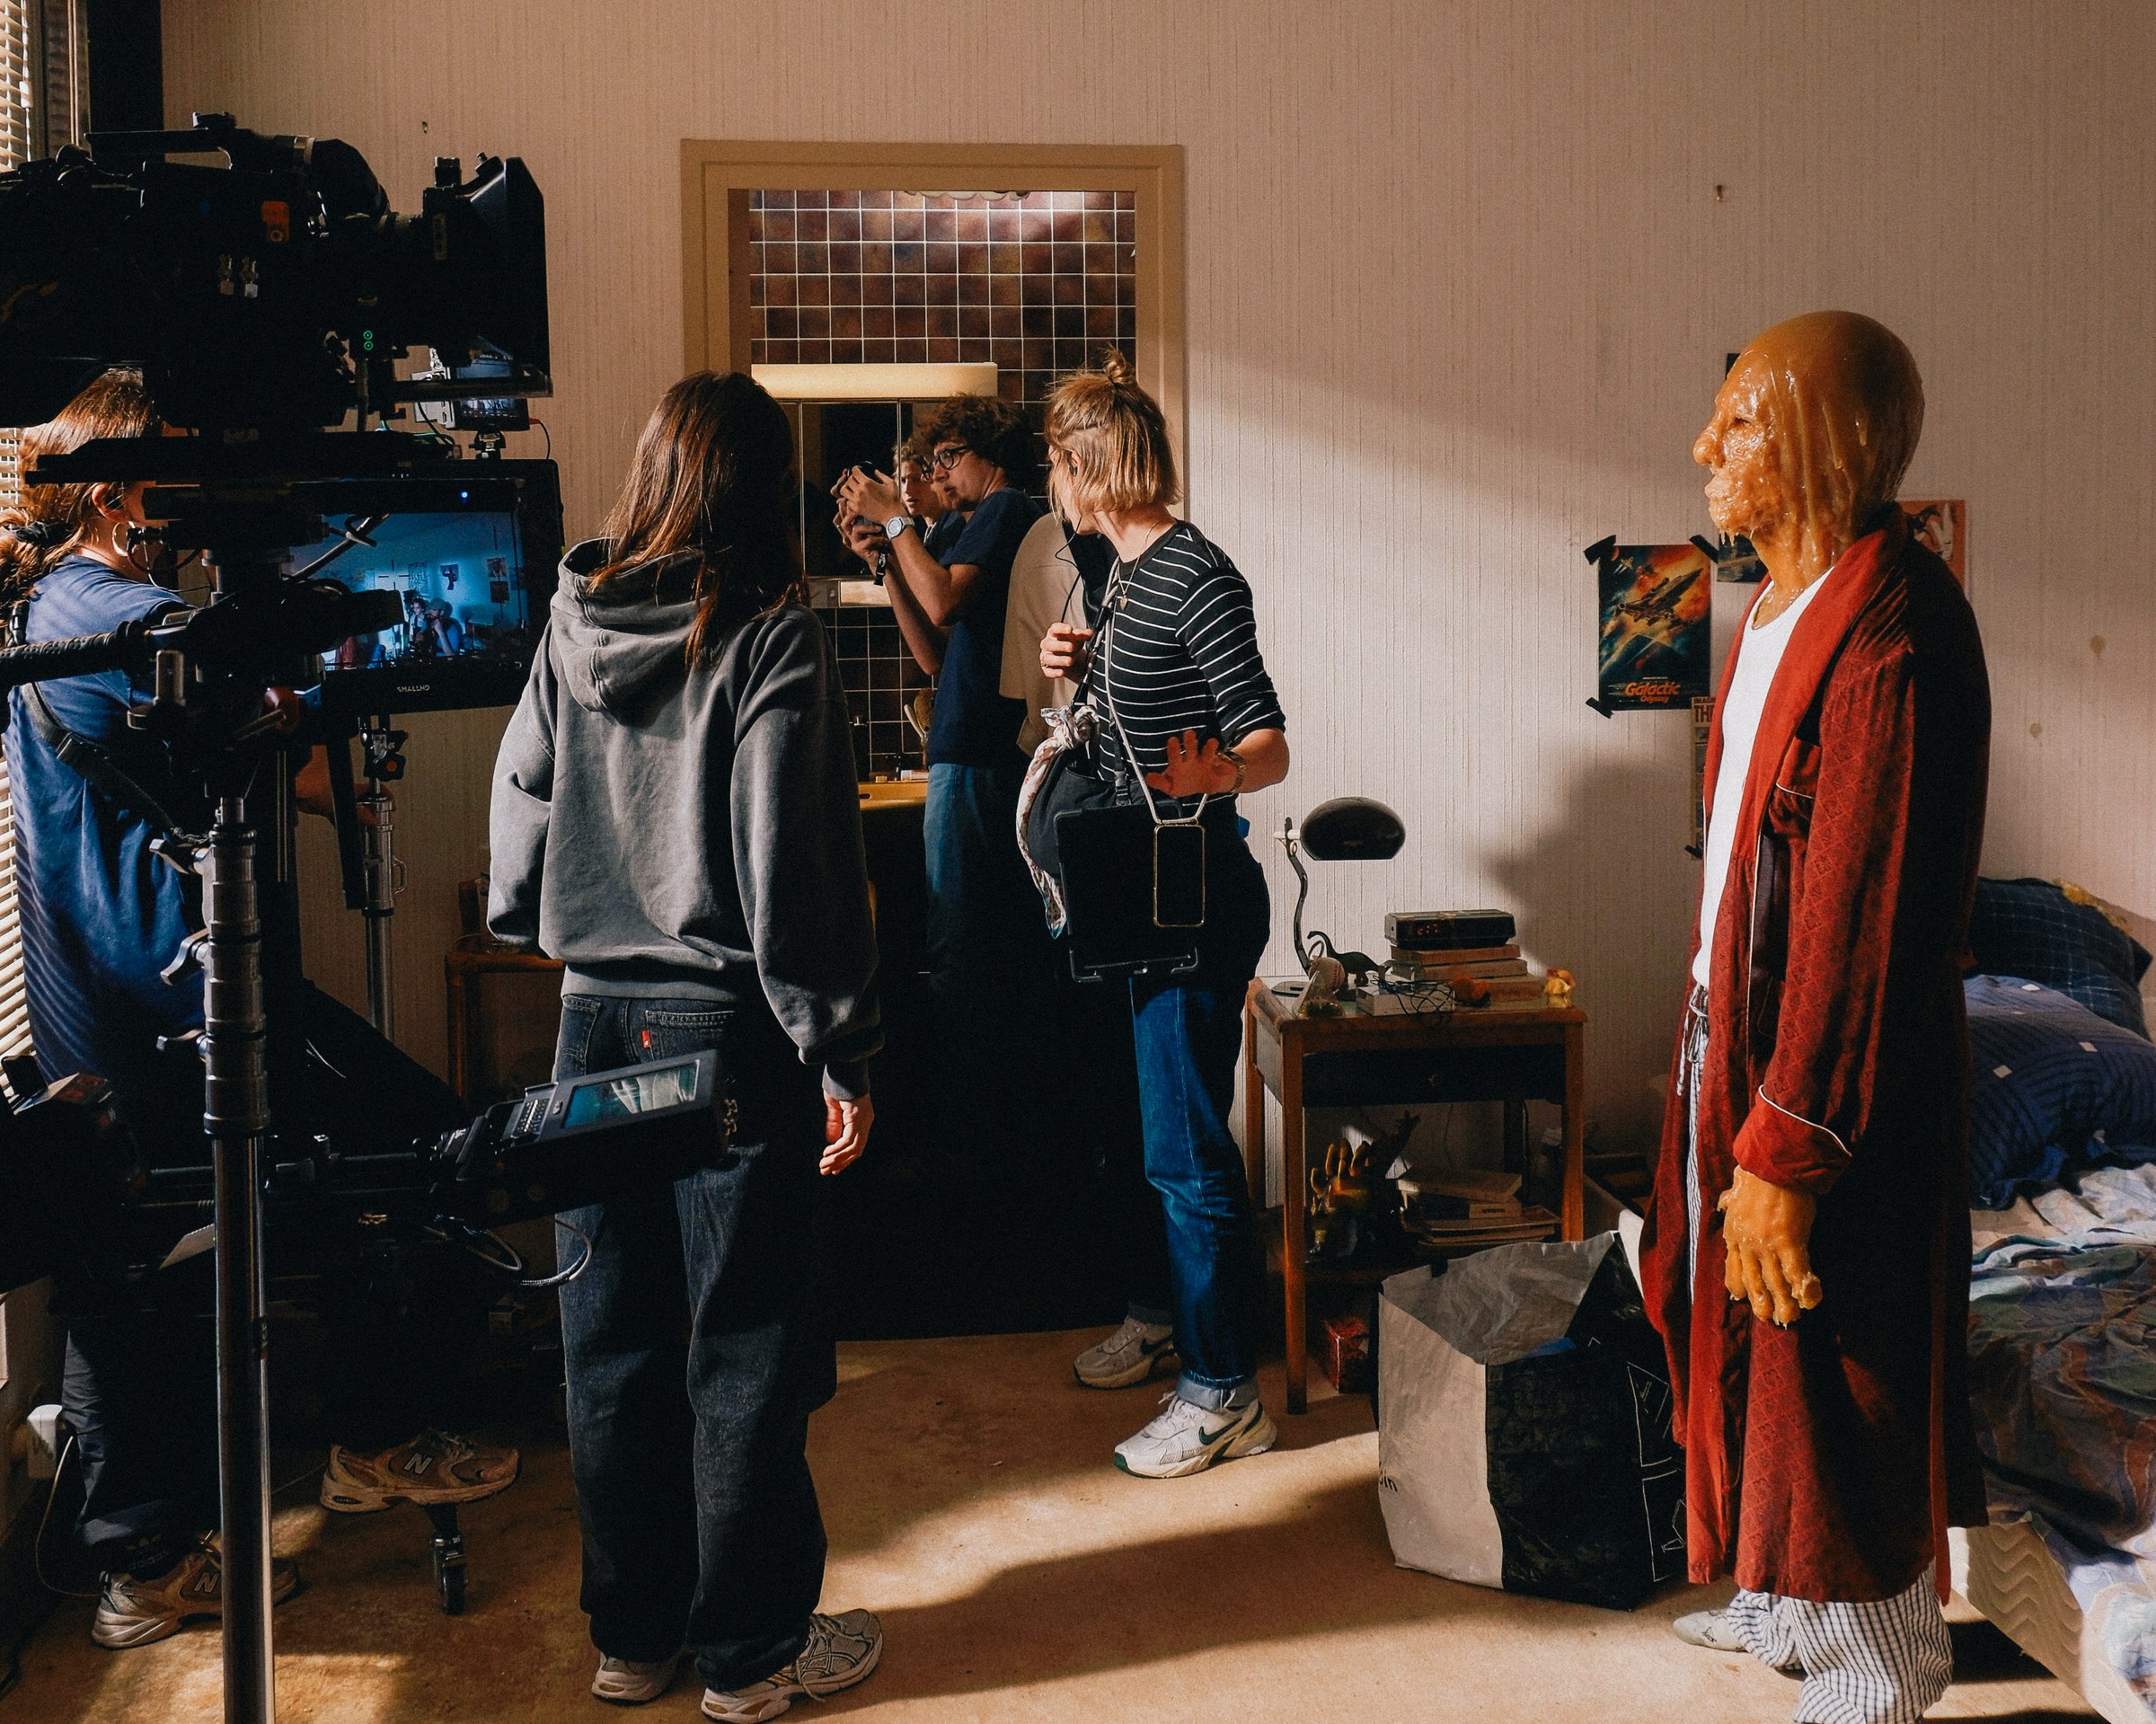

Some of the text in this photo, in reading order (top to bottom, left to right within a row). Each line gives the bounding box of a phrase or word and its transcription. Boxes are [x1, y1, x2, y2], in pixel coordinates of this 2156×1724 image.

[397, 685, 430, 693] SMALLHD
[1625, 682, 1681, 696] Galactic
[1640, 695, 1669, 703] Odyssey
[403, 1453, 433, 1474] N
[194, 1572, 220, 1592] N
